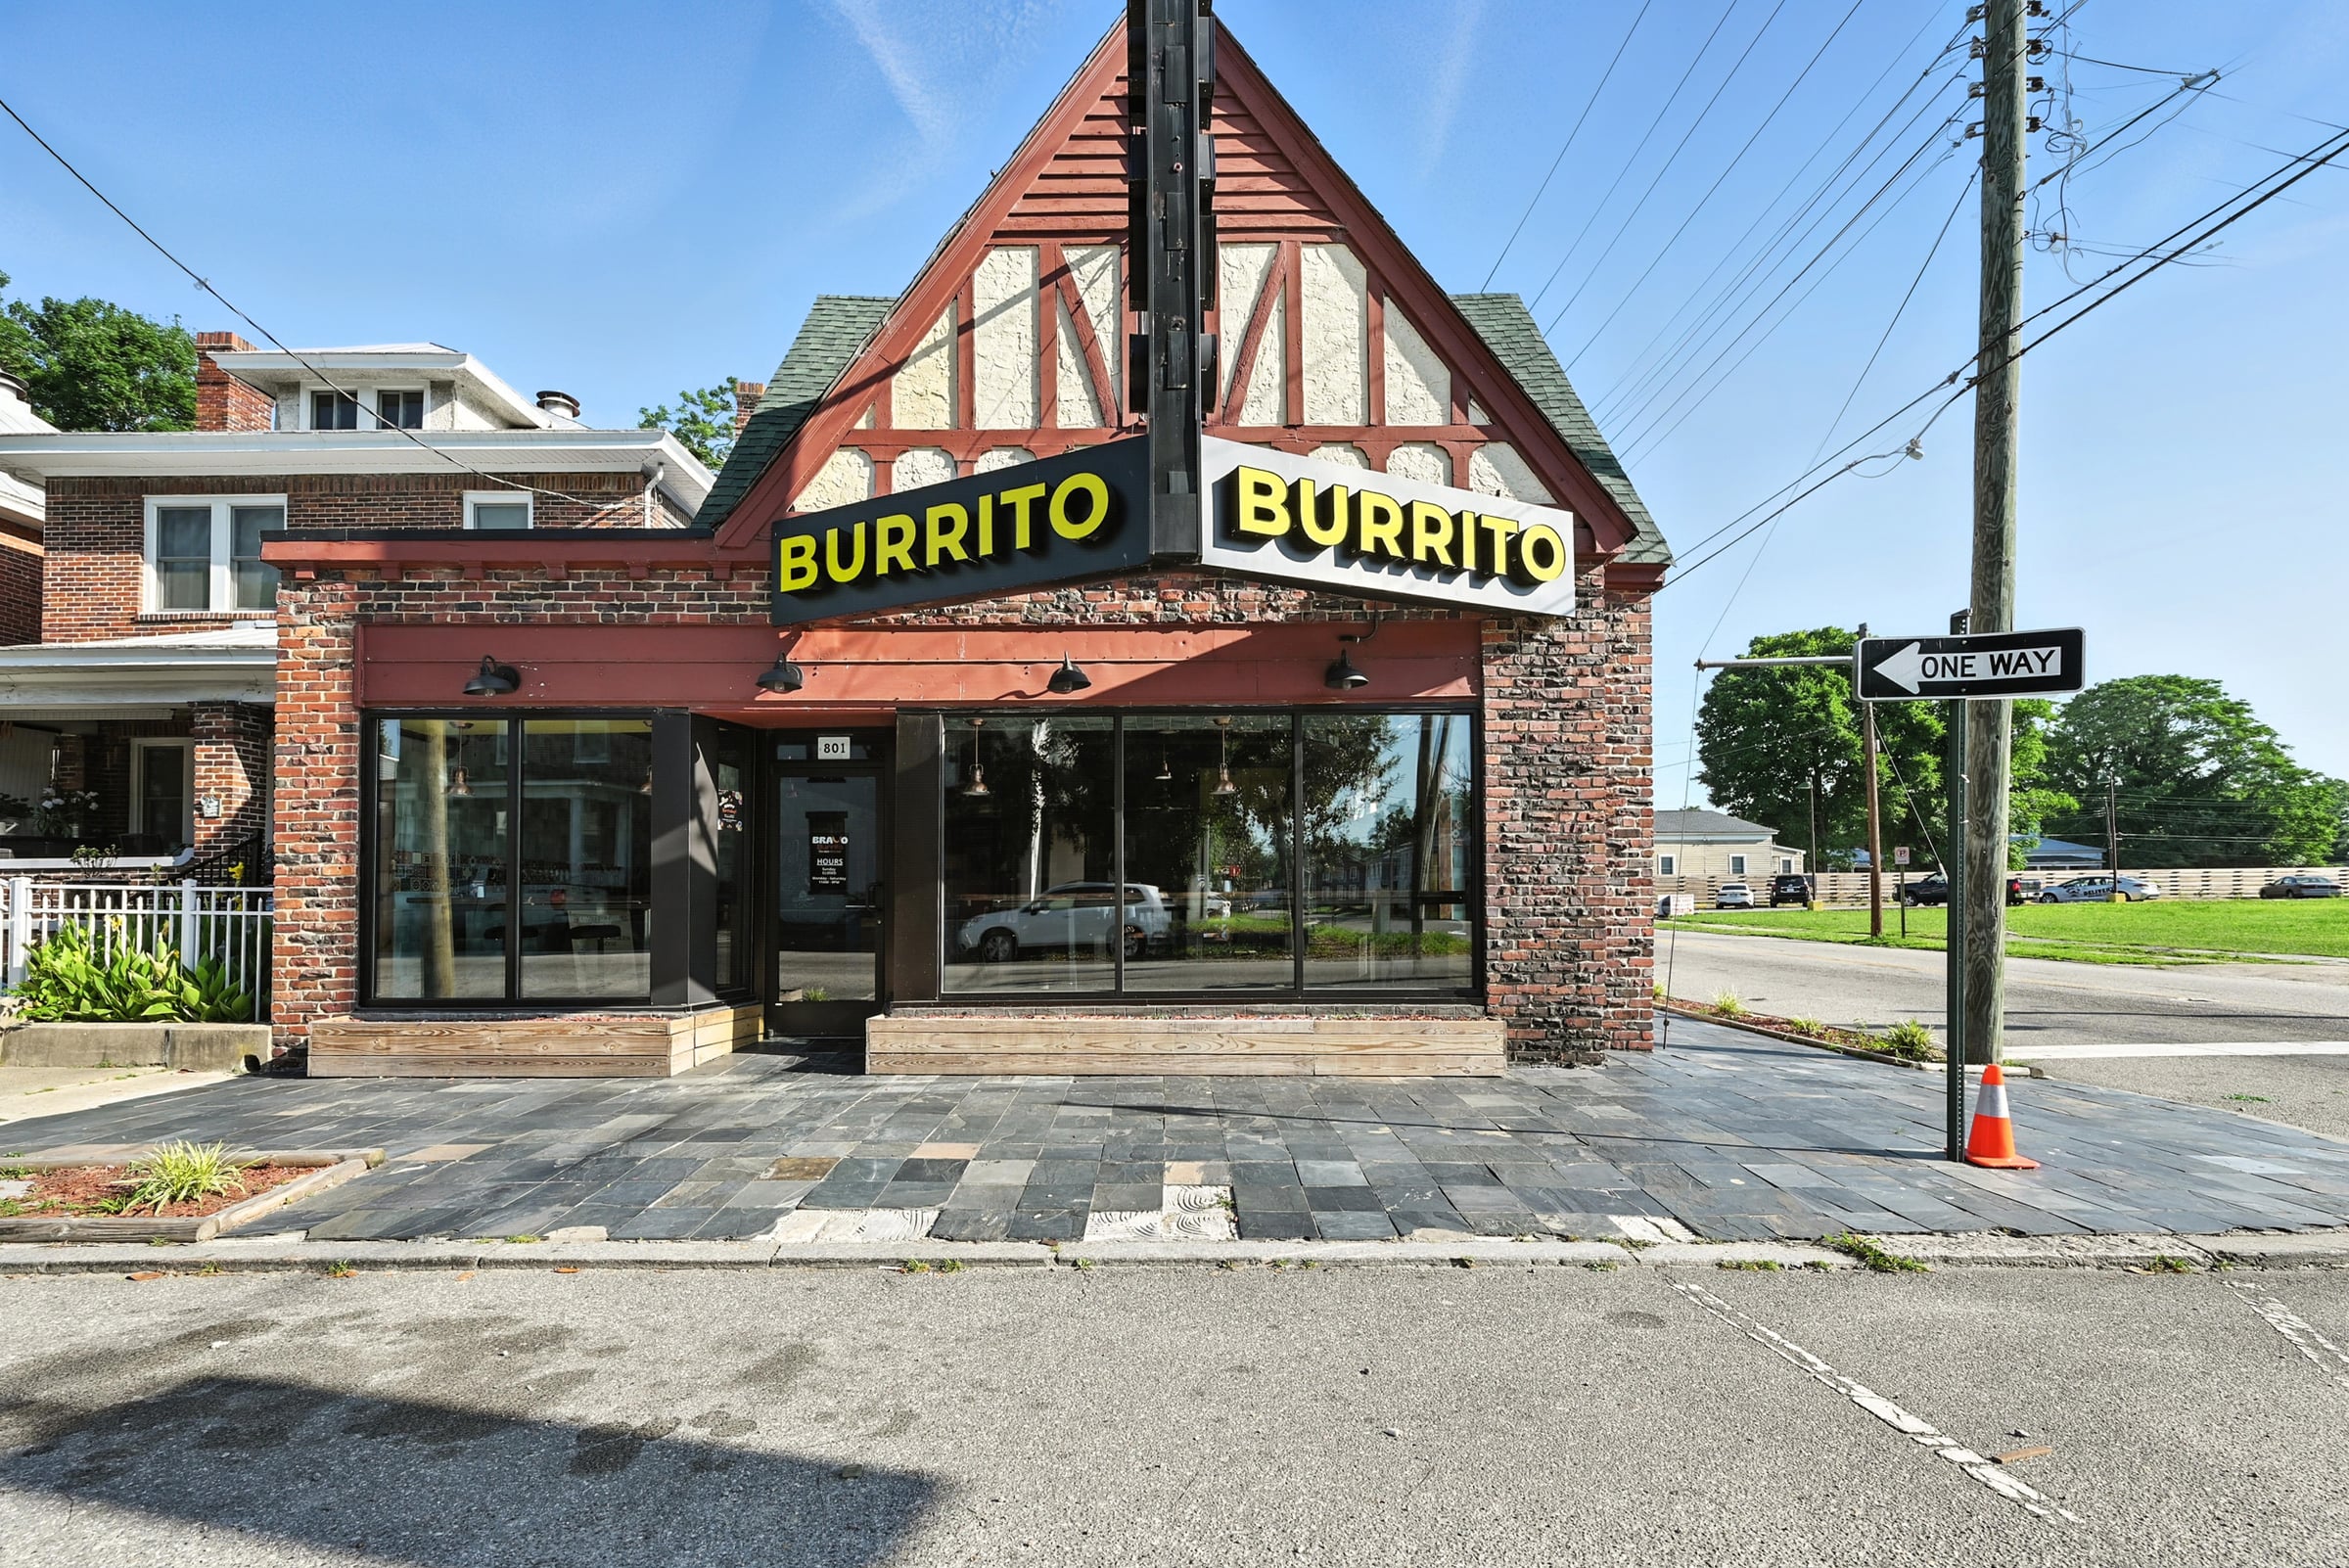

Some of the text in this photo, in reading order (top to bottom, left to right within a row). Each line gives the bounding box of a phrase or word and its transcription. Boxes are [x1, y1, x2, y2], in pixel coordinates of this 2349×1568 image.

[780, 473, 1108, 592] BURRITO
[1237, 466, 1566, 582] BURRITO
[1921, 650, 2055, 678] ONE WAY
[824, 743, 846, 754] 801
